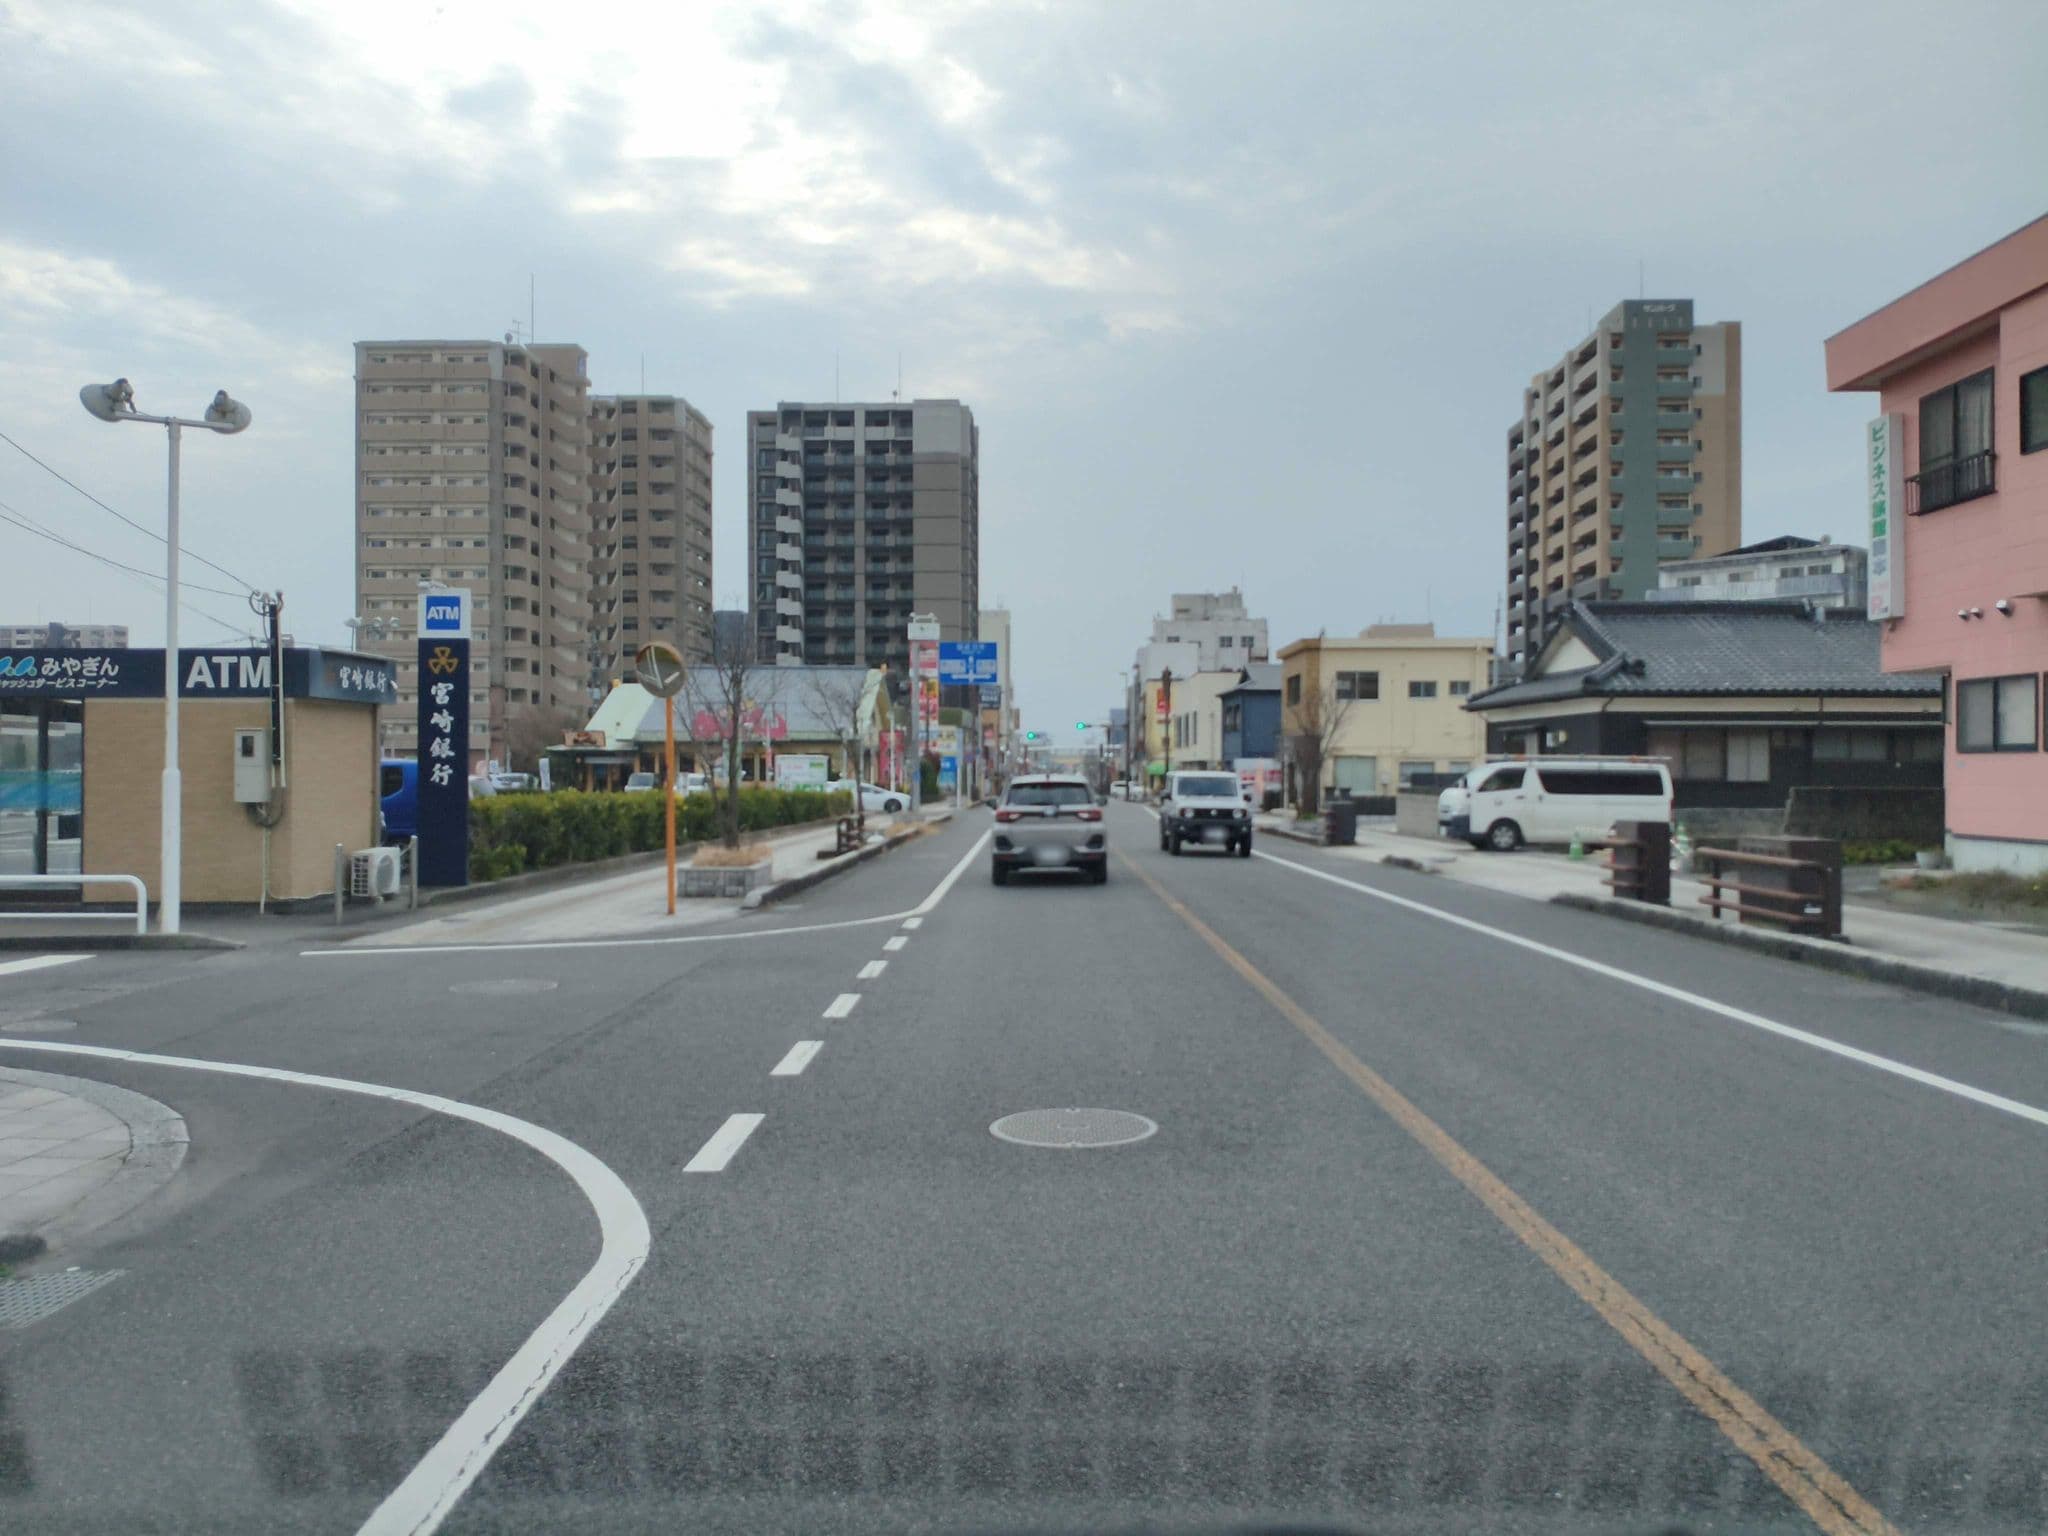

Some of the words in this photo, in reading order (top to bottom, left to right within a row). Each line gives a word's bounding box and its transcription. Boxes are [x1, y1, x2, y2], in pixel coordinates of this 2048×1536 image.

[427, 606, 459, 620] ATM
[41, 656, 119, 676] みやぎん
[185, 655, 271, 689] ATM
[0, 677, 119, 689] ャッシュサービスコーナー
[429, 681, 456, 787] 宮崎銀行
